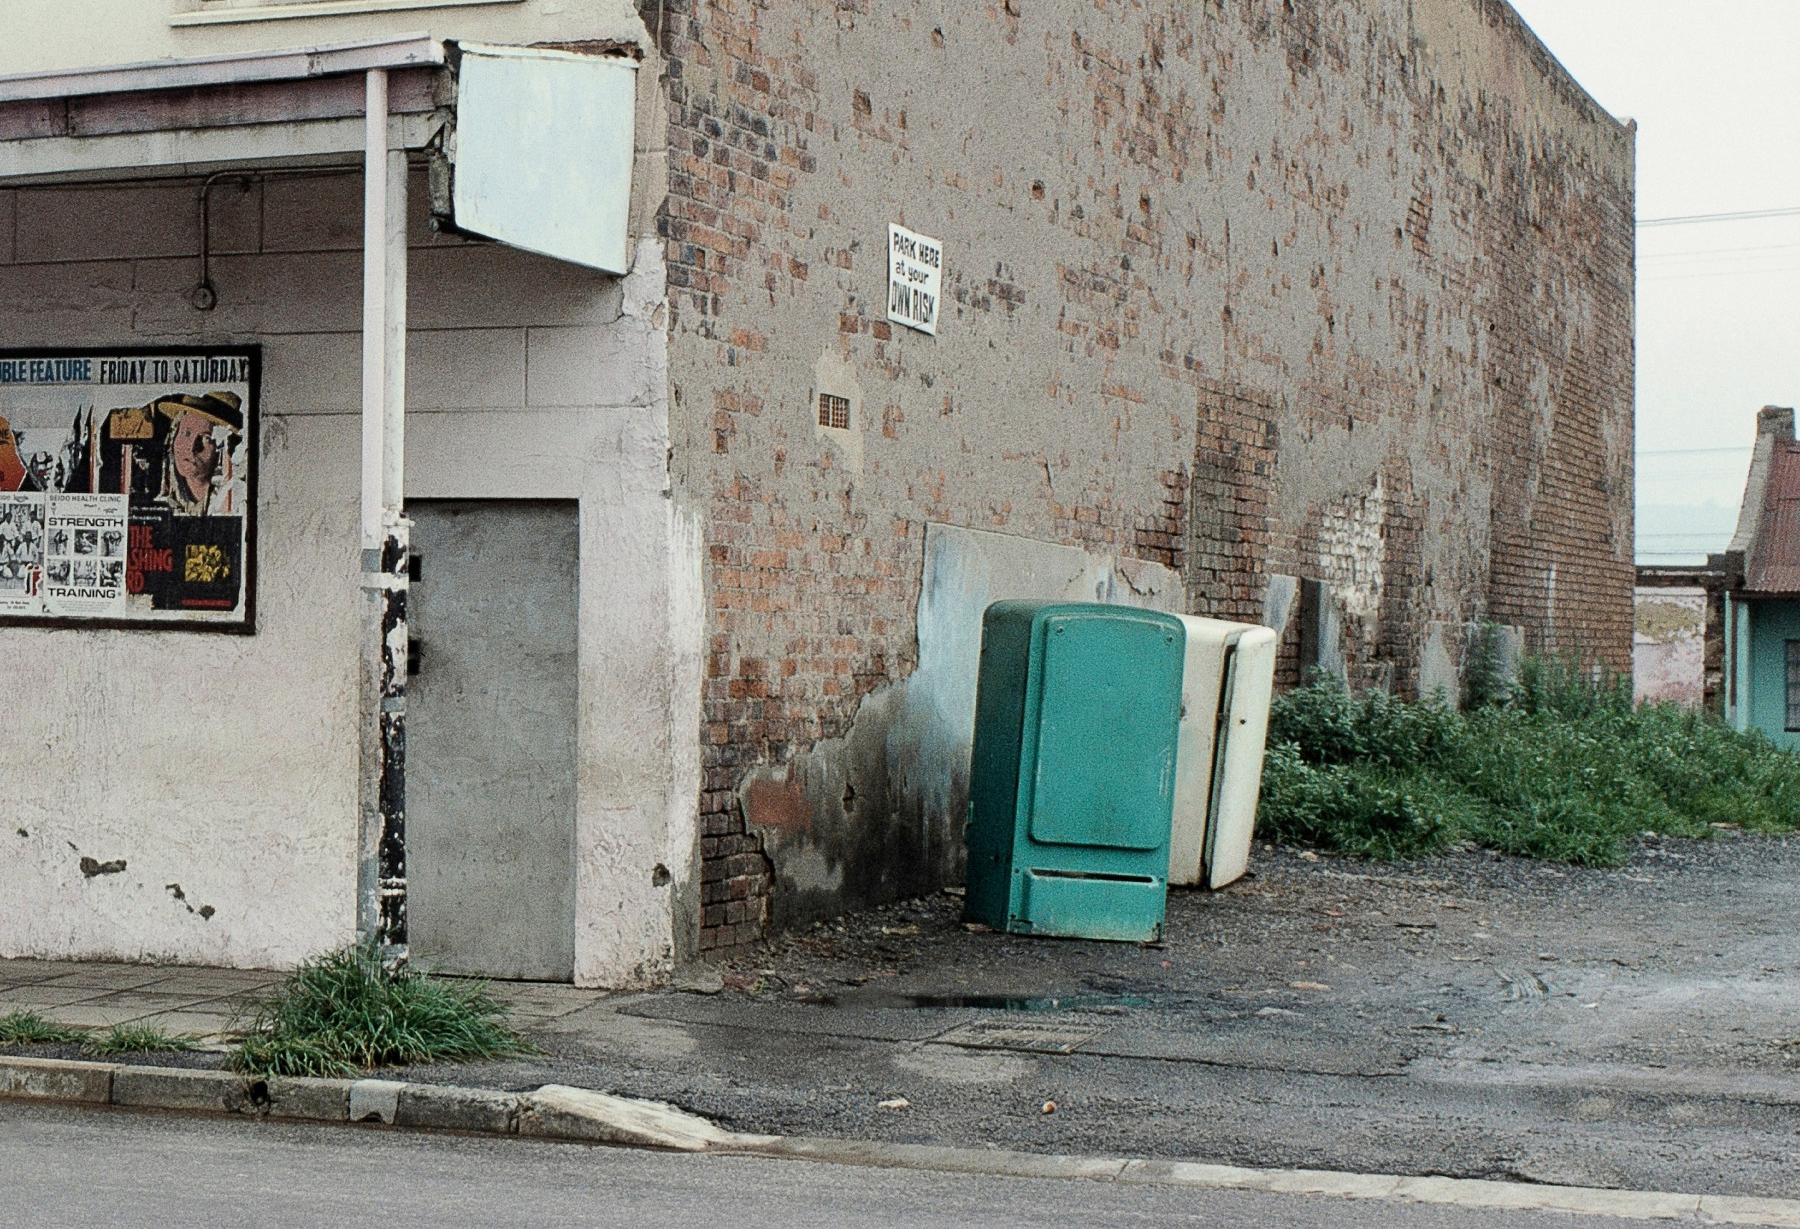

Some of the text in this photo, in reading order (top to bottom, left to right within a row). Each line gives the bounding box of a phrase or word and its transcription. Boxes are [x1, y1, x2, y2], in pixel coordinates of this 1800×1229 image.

[893, 232, 940, 269] PARK HERE
[895, 260, 930, 284] at your
[891, 280, 936, 324] OWN RISK
[29, 359, 92, 382] FEATURE
[100, 360, 146, 384] FRIDAY
[153, 360, 168, 383] TO
[174, 358, 249, 383] SATURDAY
[48, 517, 124, 527] STRENGTH
[129, 525, 153, 548] THE
[47, 588, 116, 599] TRAINING
